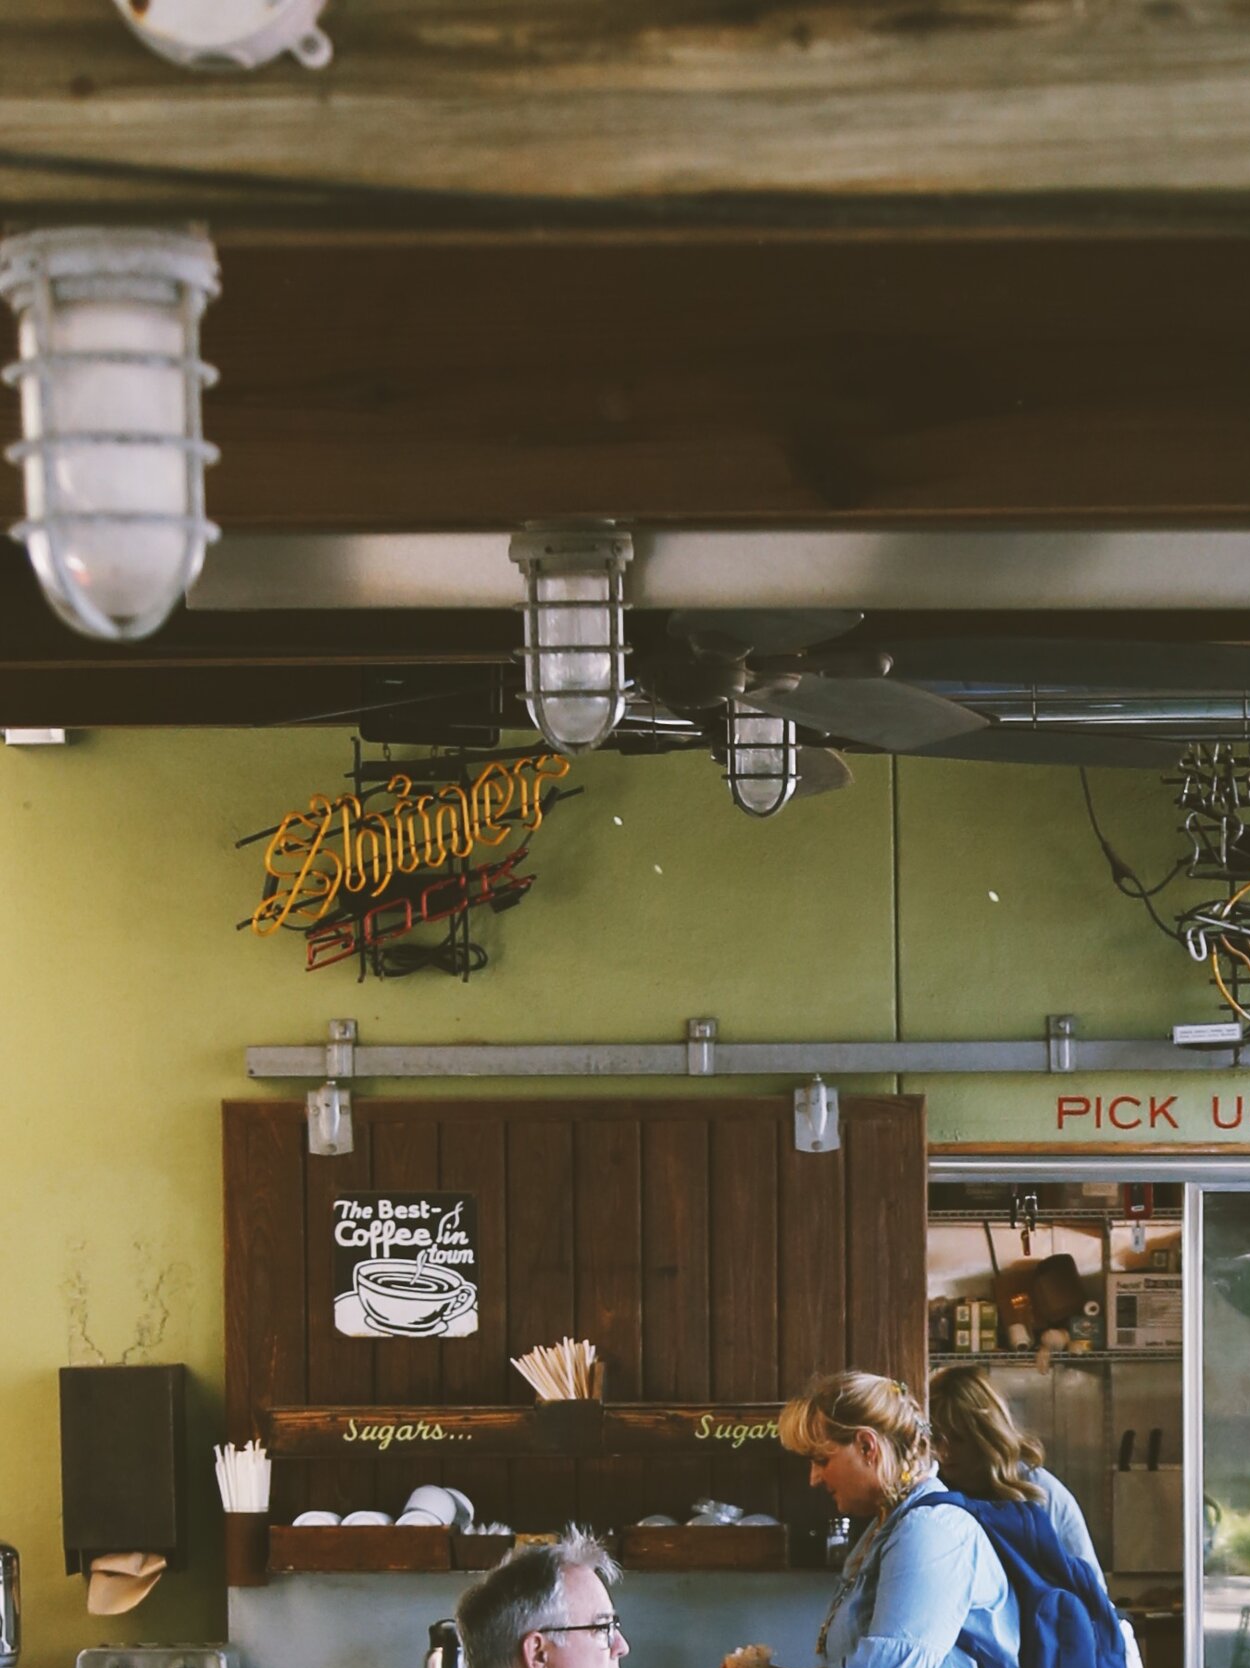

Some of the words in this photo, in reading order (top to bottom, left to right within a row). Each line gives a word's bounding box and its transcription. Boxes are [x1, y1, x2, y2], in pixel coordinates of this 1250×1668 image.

[252, 754, 570, 936] Shiner
[305, 848, 536, 971] BOCK
[1057, 1096, 1179, 1130] PICK
[333, 1200, 373, 1219] The
[334, 1220, 432, 1258] Coffee
[442, 1223, 469, 1245] in
[427, 1243, 475, 1264] town
